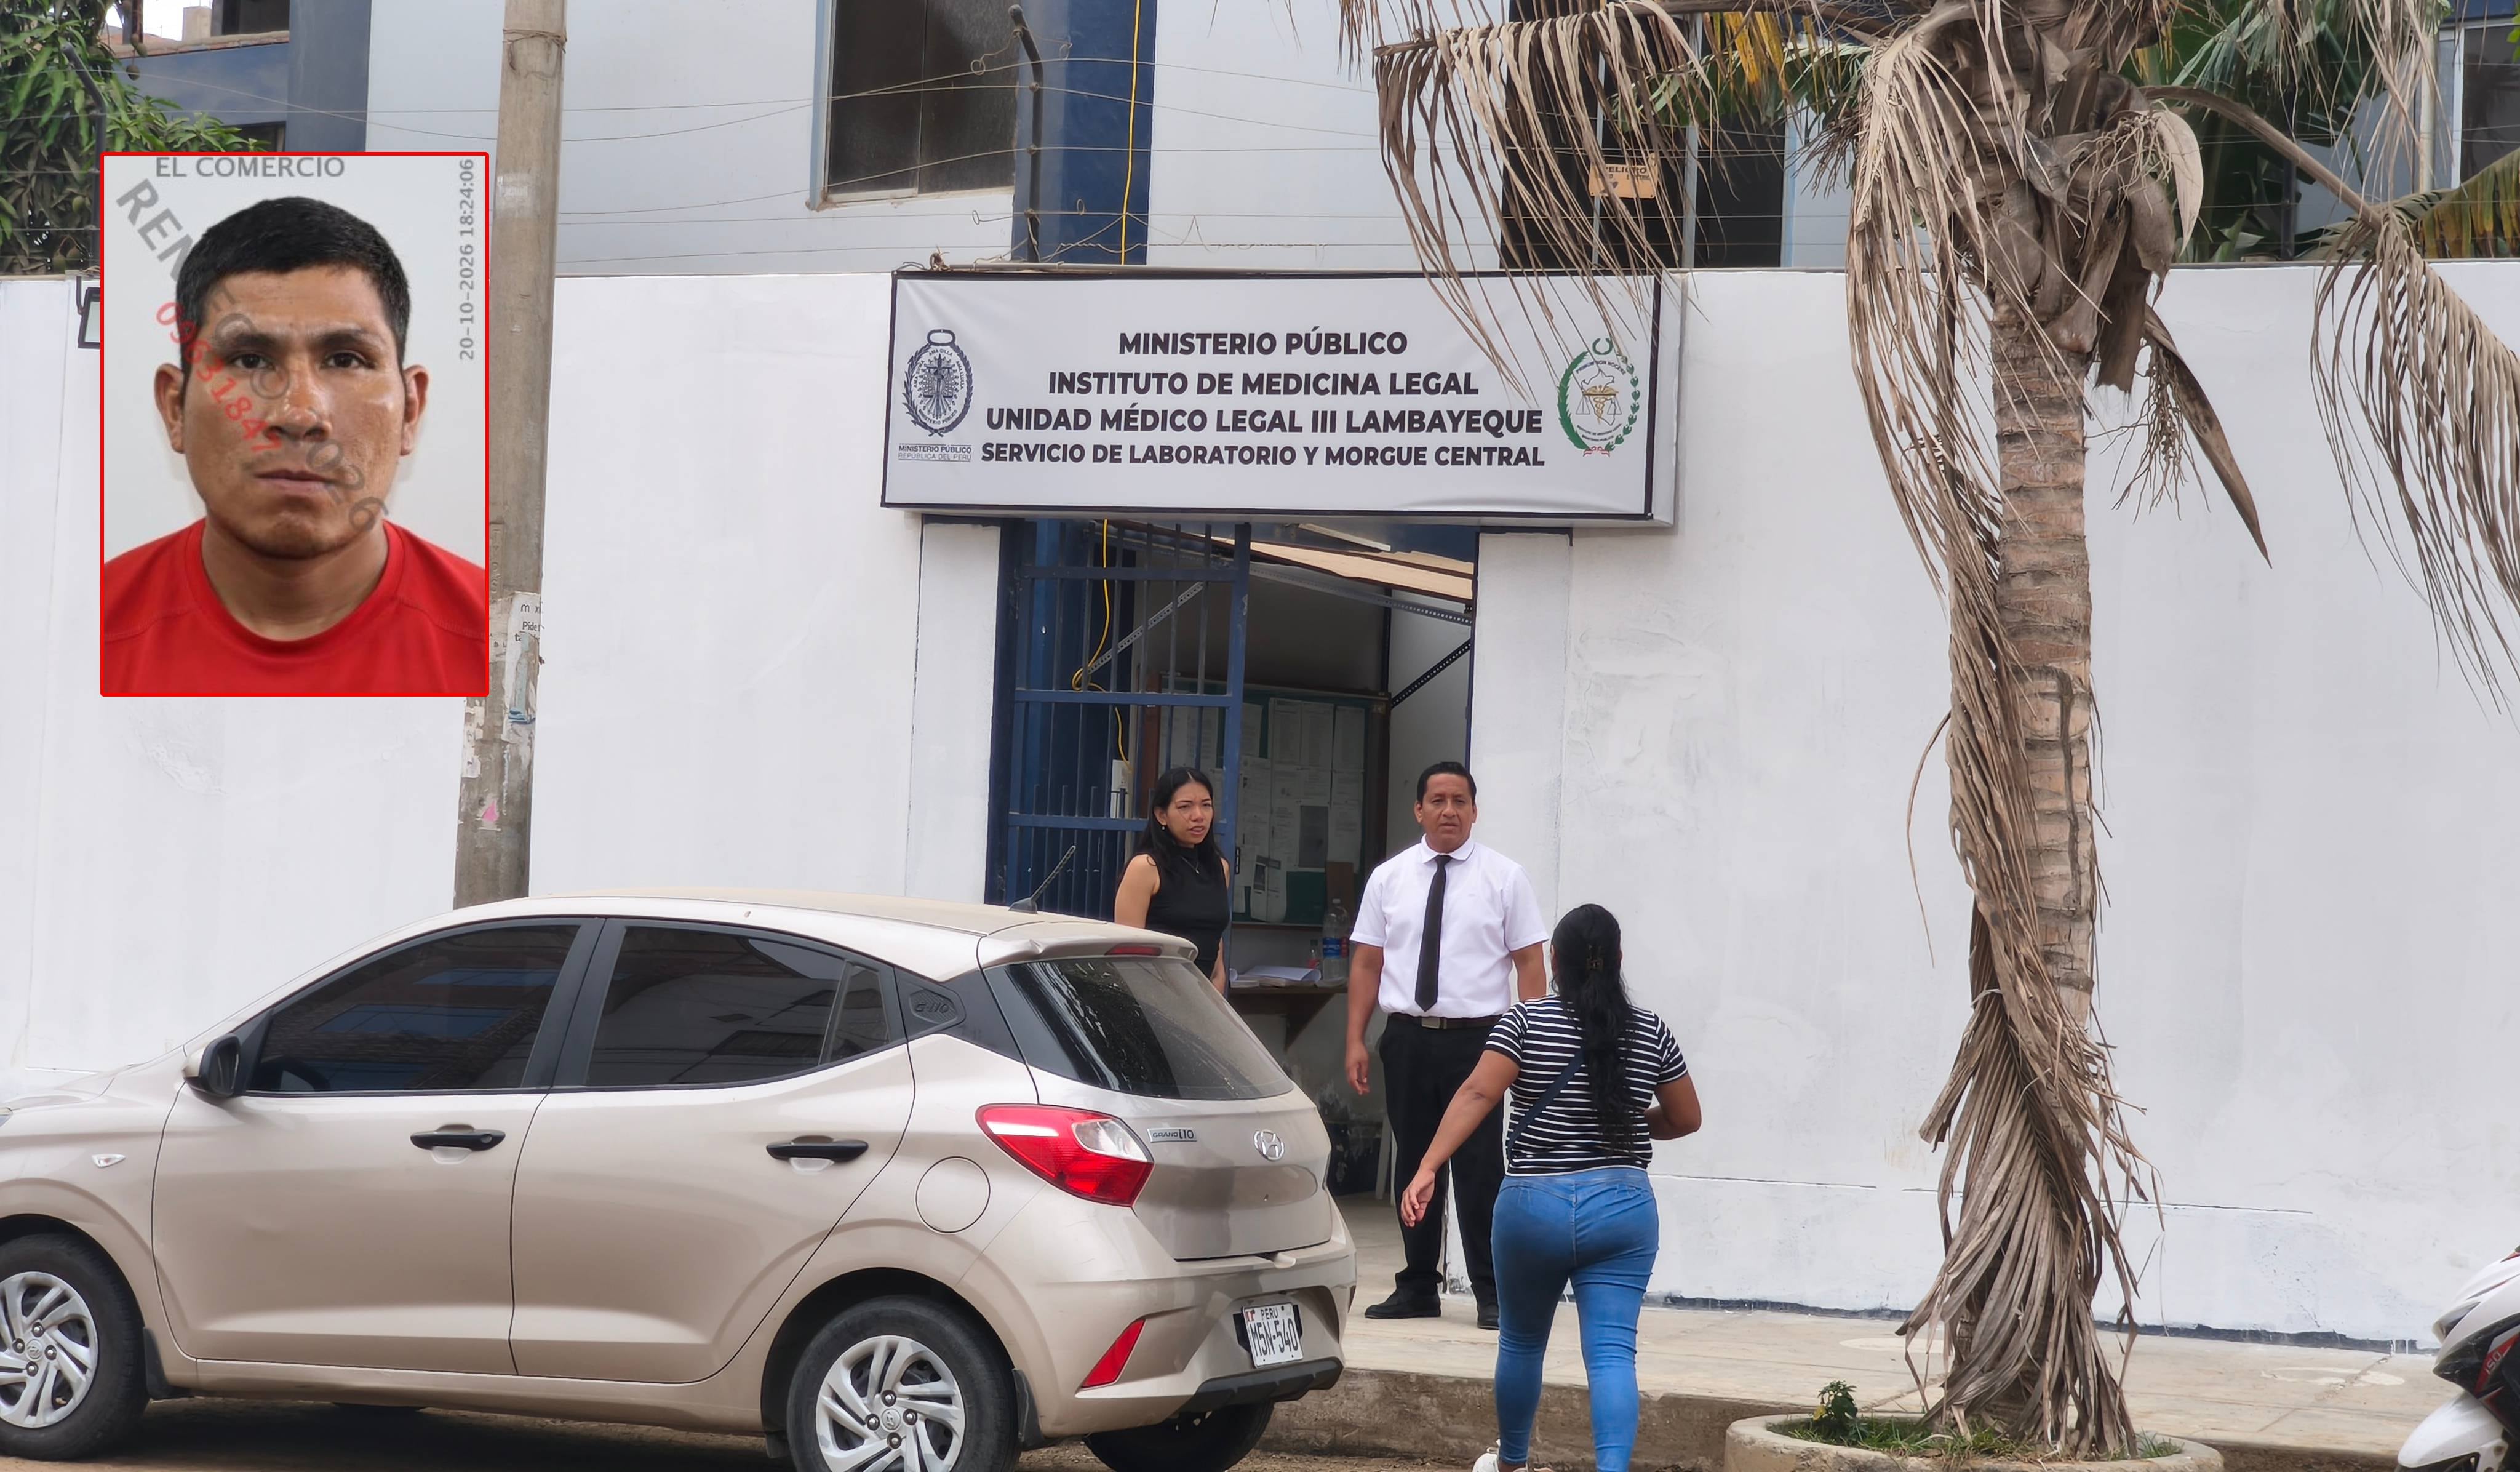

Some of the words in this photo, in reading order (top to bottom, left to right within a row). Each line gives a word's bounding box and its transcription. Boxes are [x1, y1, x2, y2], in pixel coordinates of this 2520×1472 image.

[1119, 332, 1277, 356] MINISTERIO
[1285, 326, 1408, 356] PÚBLICO
[1049, 372, 1188, 395] INSTITUTO
[1197, 372, 1234, 395] DE
[1242, 372, 1381, 396] MEDICINA
[1389, 372, 1479, 396] LEGAL
[987, 407, 1092, 431] UNIDAD
[1100, 403, 1208, 432] MÉDICO
[1216, 409, 1303, 433] LEGAL
[1311, 410, 1337, 433] III
[1346, 409, 1542, 439] LAMBAYEQUE
[898, 445, 939, 453] MINISTERIO
[940, 444, 972, 454] PÚBLICO
[981, 442, 1085, 463] SERVICIO
[1092, 444, 1123, 463] DE
[1129, 444, 1296, 465] LABORATORIO
[1302, 446, 1319, 465] Y
[1325, 446, 1427, 466] MORGUE
[1434, 446, 1545, 466] CENTRAL
